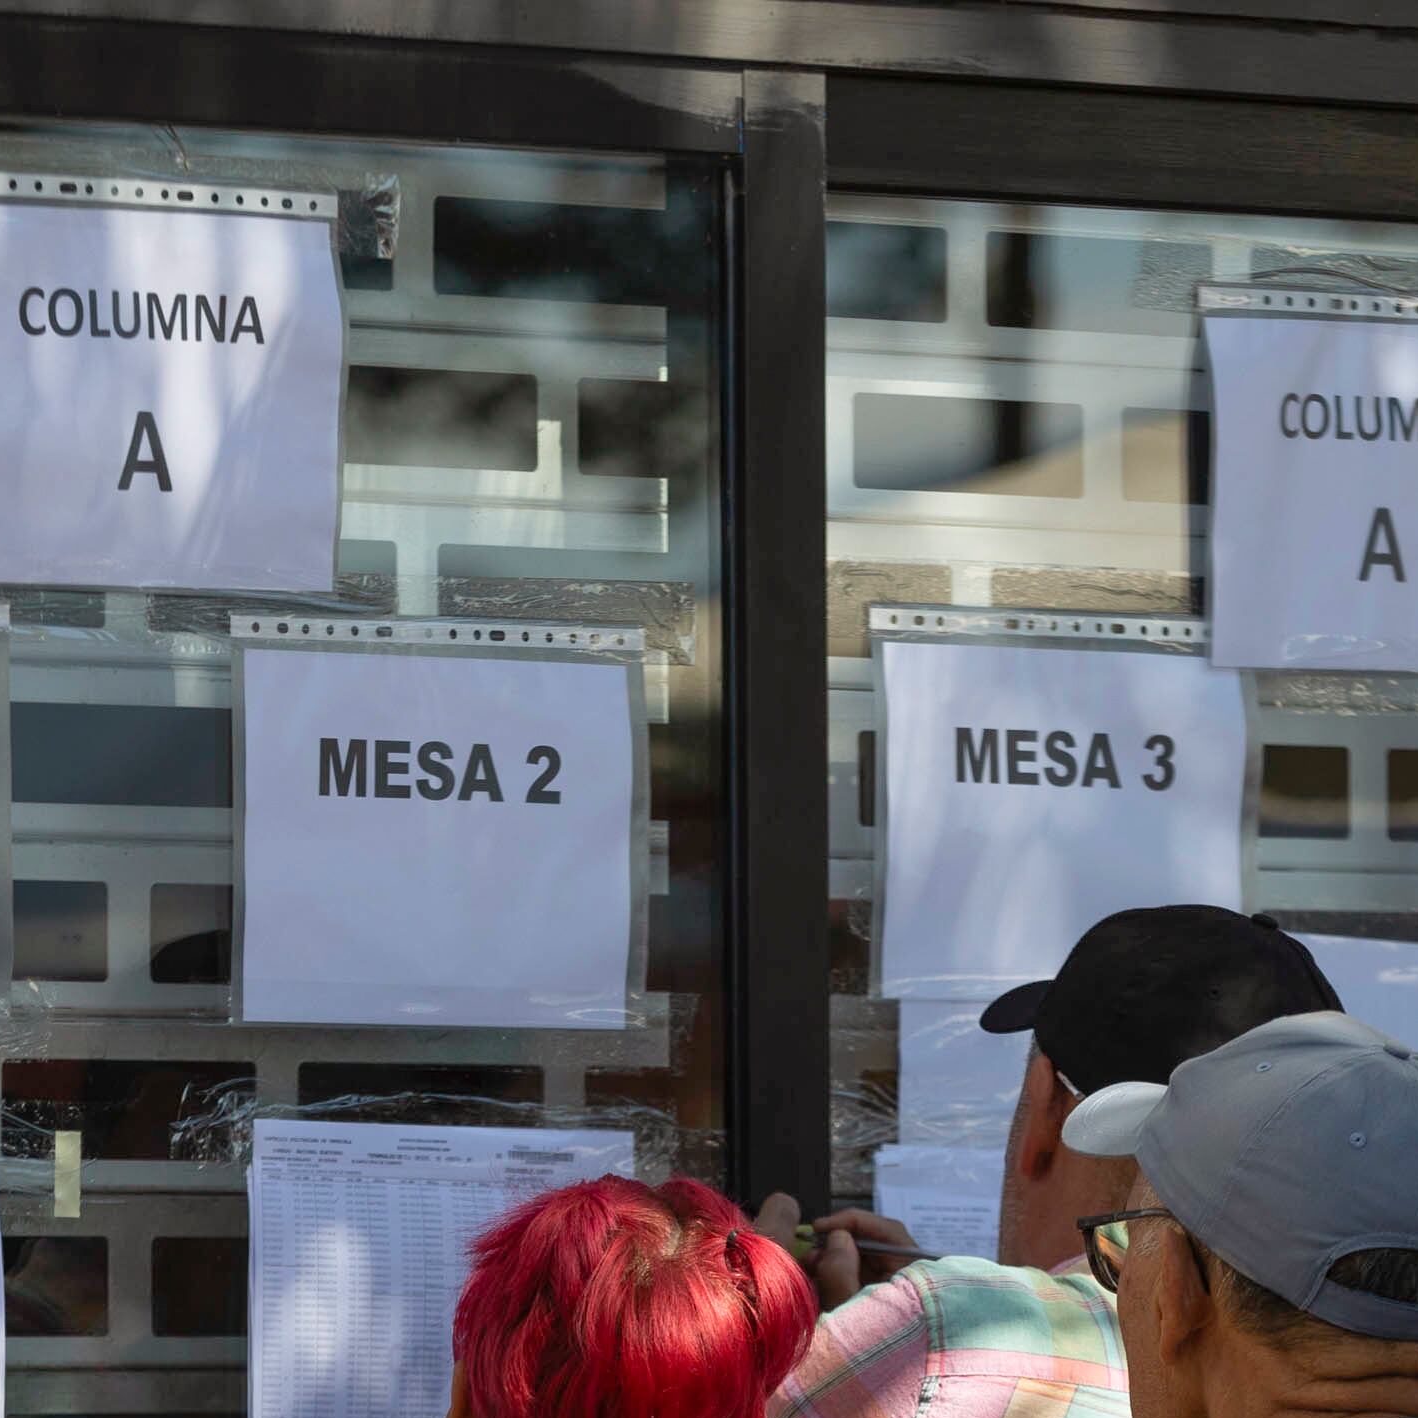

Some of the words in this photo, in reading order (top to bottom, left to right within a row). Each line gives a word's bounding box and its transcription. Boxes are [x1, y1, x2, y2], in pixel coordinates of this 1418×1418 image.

[18, 286, 265, 345] COLUMNA
[117, 411, 173, 493] A
[1358, 507, 1405, 583] A
[318, 737, 504, 803] MESA
[525, 745, 562, 805] 2
[955, 727, 1122, 789] MESA
[1142, 734, 1175, 792] 3
